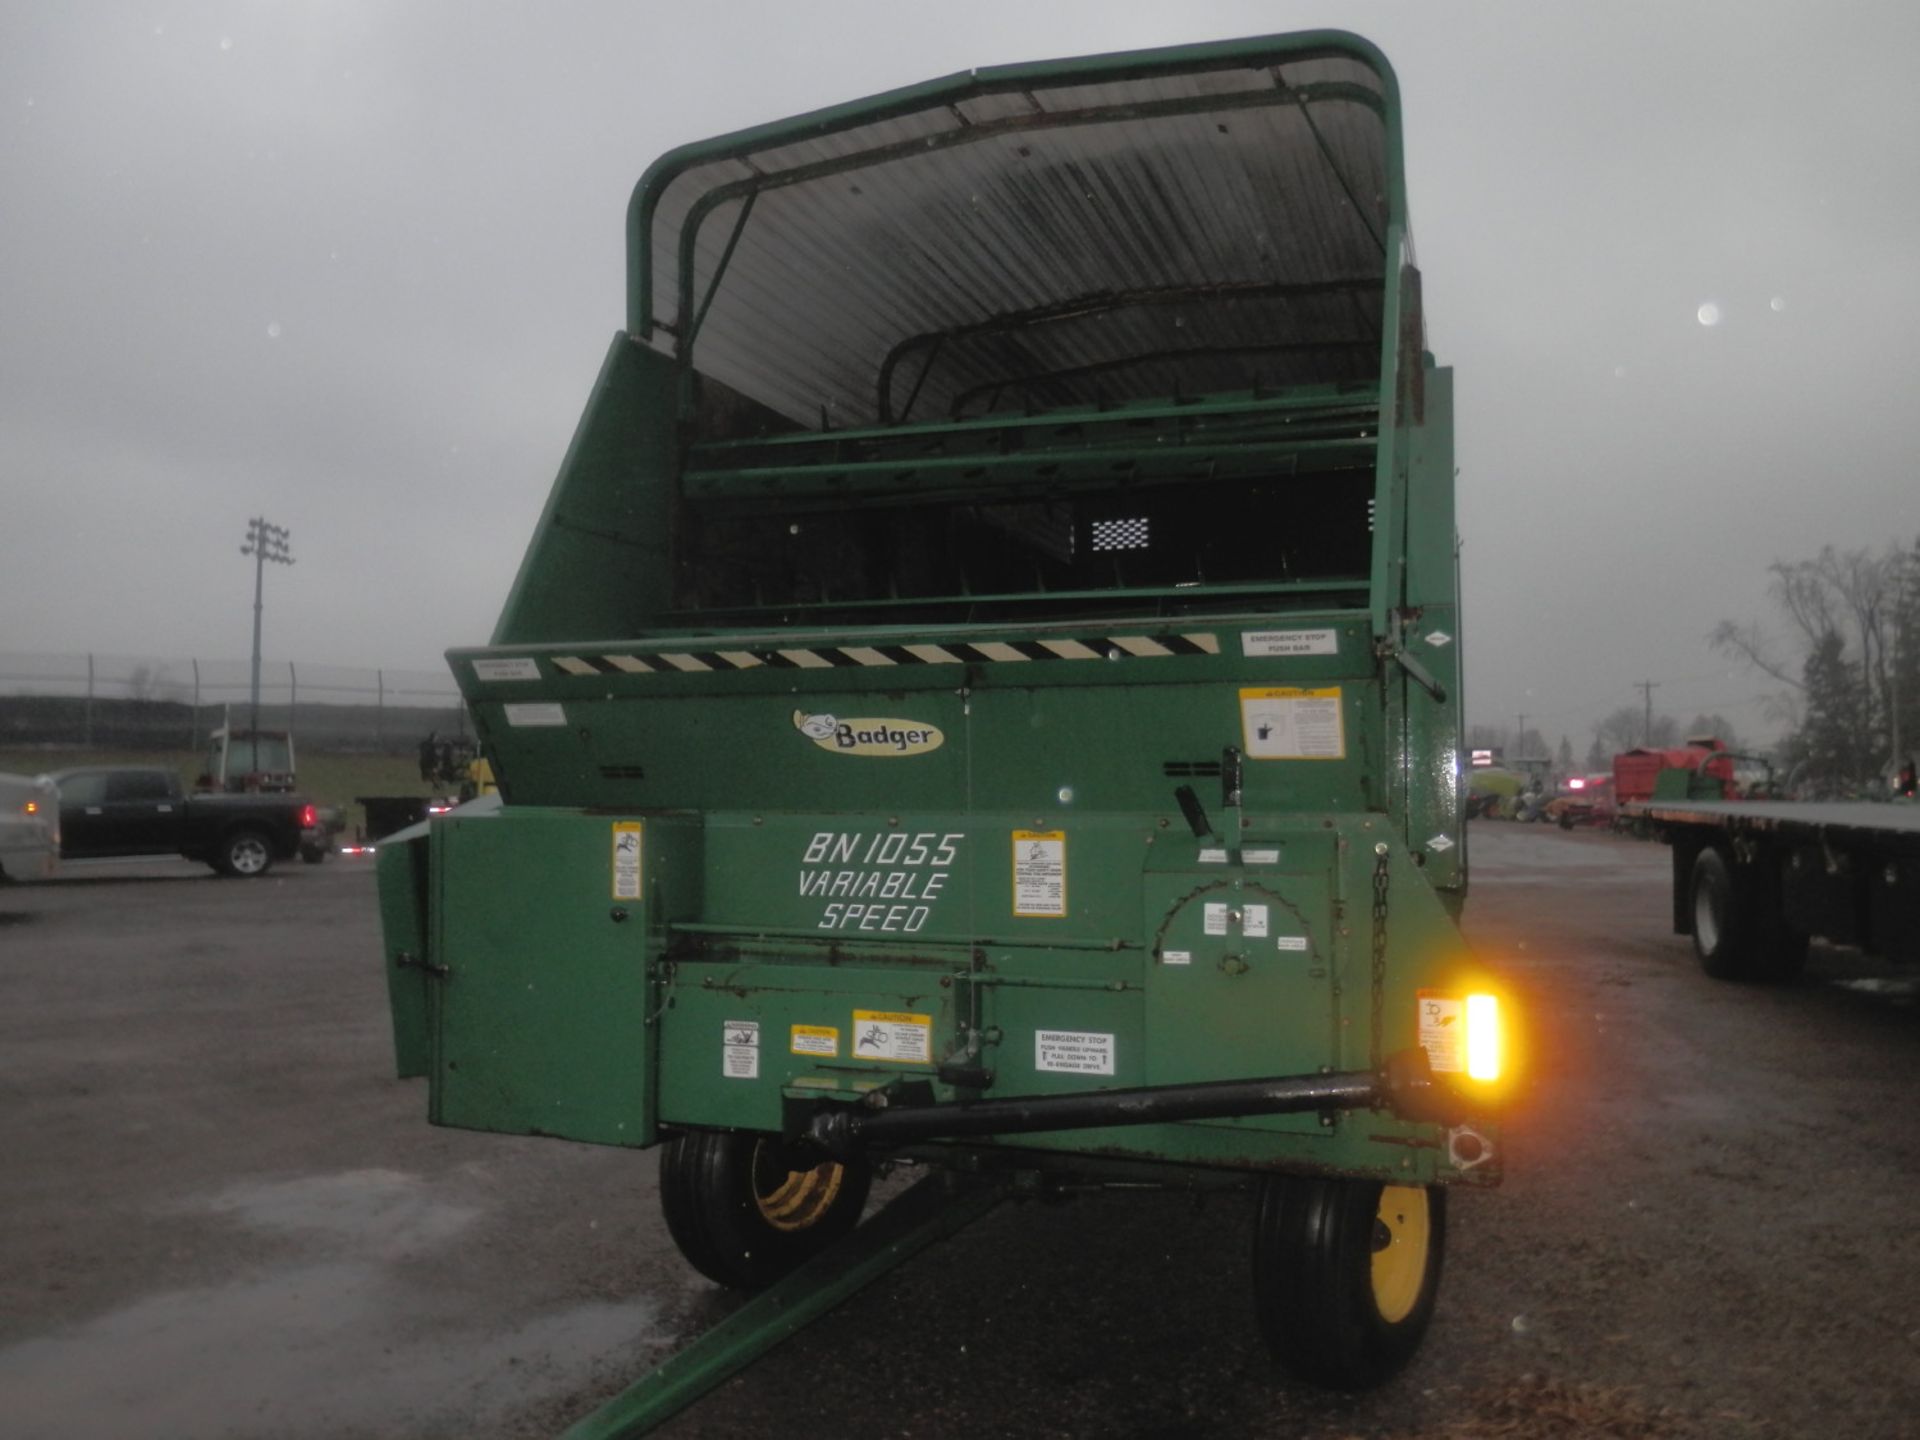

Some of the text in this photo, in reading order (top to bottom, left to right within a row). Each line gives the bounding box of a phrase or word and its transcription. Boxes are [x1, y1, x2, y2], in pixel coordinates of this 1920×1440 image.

[836, 724, 934, 750] Badger
[802, 832, 965, 865] BN 1055
[799, 870, 949, 899] VARIABLE
[818, 903, 929, 932] SPEED
[1041, 1034, 1107, 1044] EMERGENCY STOP
